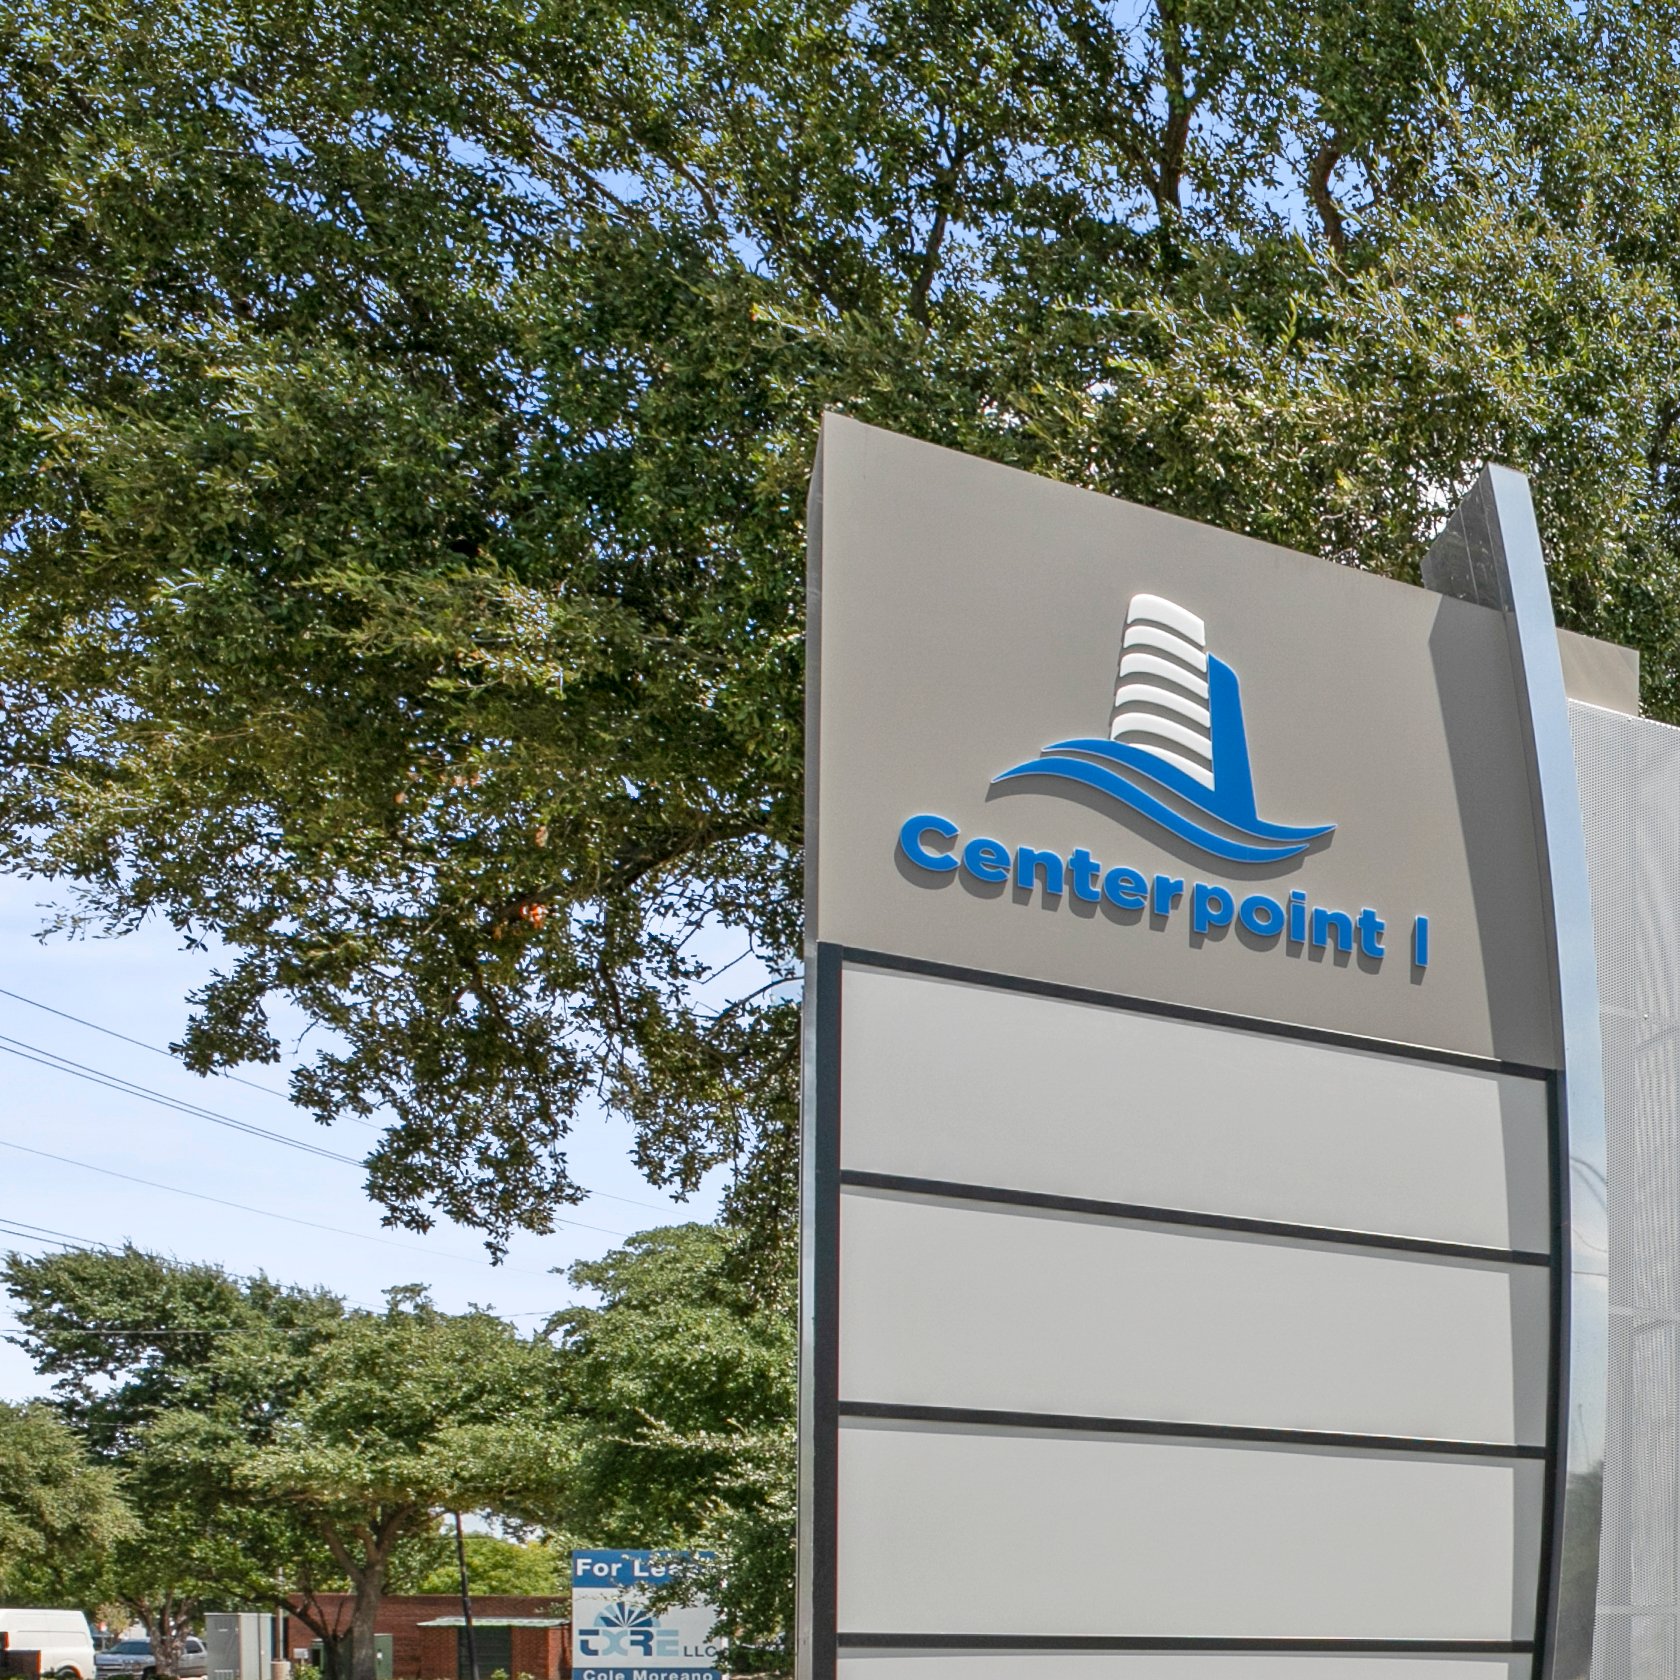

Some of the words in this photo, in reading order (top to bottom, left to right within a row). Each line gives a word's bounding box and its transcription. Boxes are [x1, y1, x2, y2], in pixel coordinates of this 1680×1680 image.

[899, 814, 1386, 959] Centerpoint
[576, 1558, 622, 1577] For
[633, 1559, 710, 1578] Lea
[683, 1645, 716, 1657] LLC
